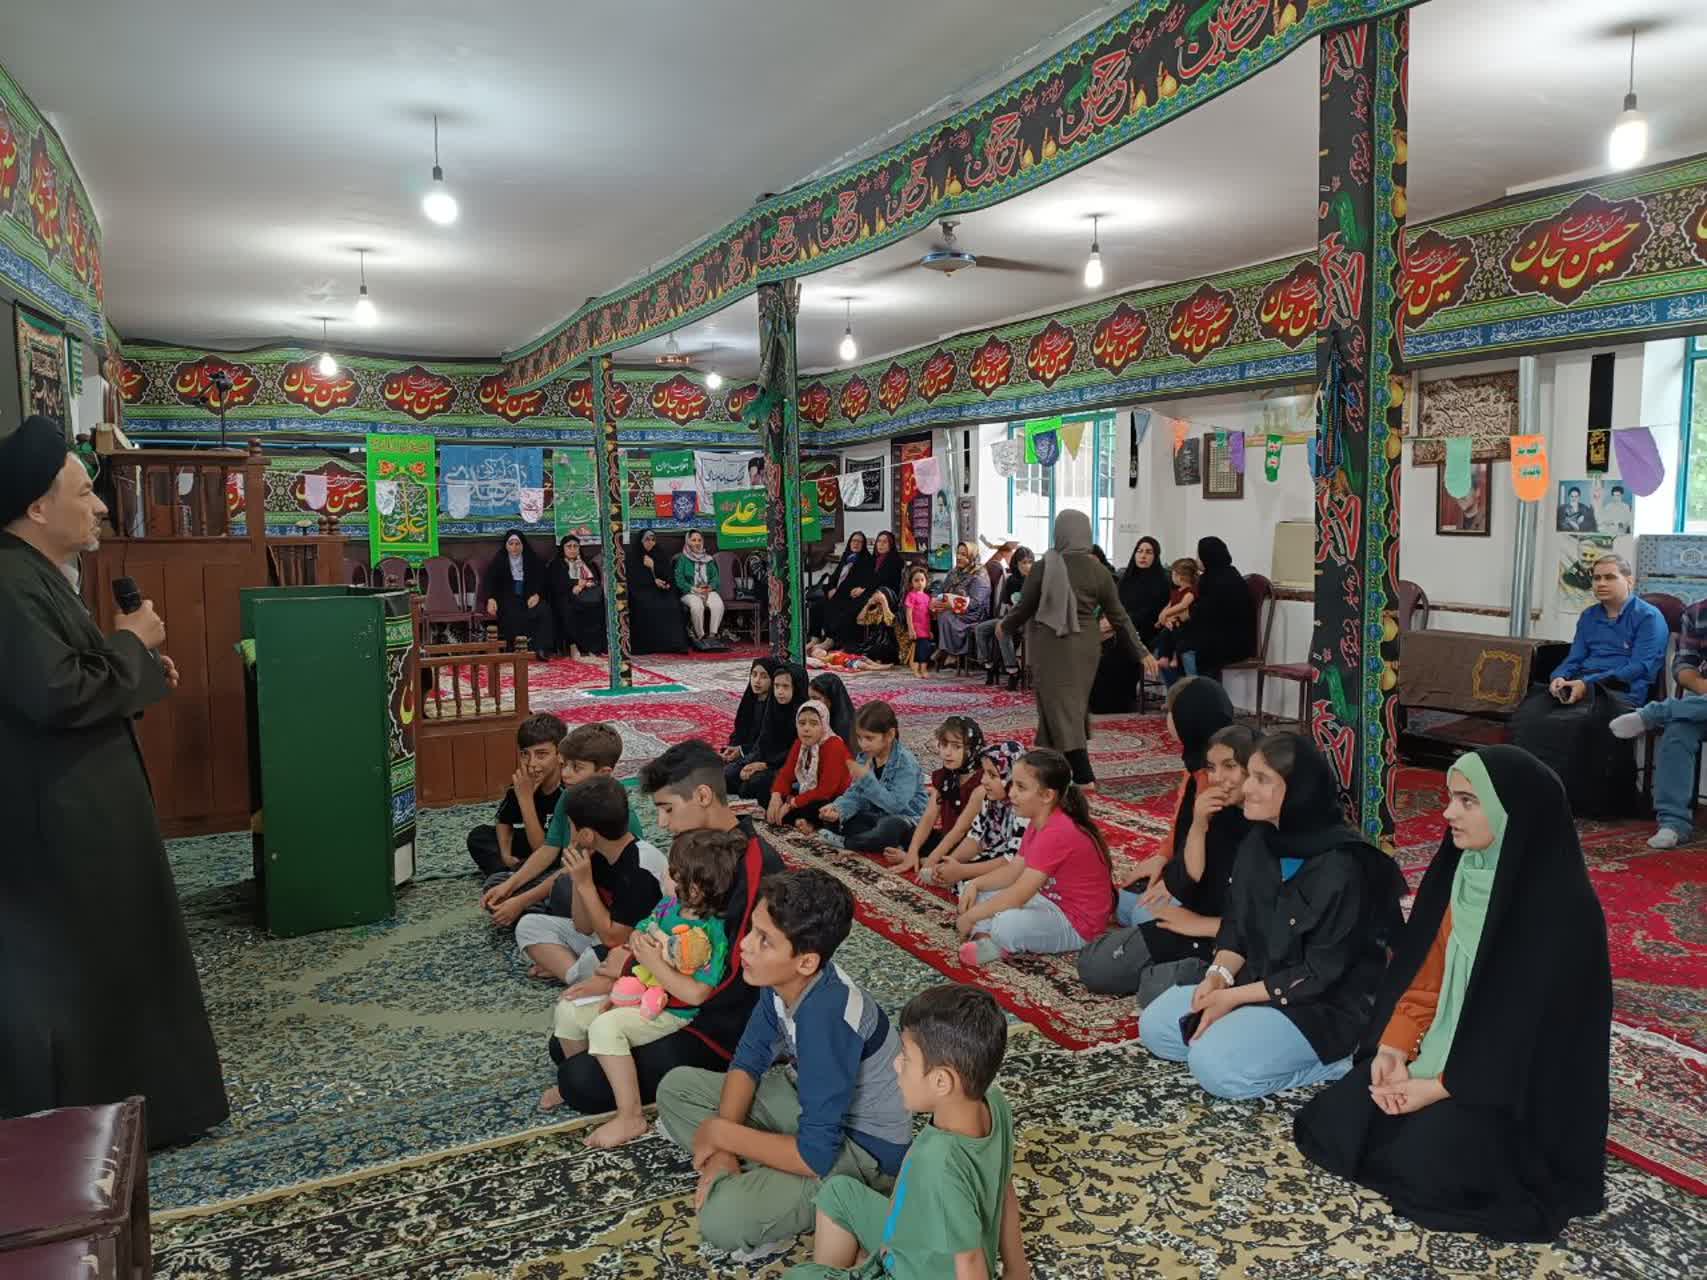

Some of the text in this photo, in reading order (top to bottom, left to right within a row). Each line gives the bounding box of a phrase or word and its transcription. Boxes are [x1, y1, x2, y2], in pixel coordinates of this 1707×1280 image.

[1511, 222, 1641, 288] حسین جان
[1408, 257, 1470, 315] حسین
[1169, 311, 1197, 349] جان
[1193, 305, 1232, 352] حسین
[1261, 290, 1295, 333] جان
[1028, 341, 1074, 379] حسین جان
[1094, 324, 1147, 367] حسین جان
[284, 368, 354, 408] حسین جان
[970, 355, 1011, 388] حسین جان
[384, 380, 452, 414] حسین جان
[479, 384, 541, 417] حسین جان
[651, 390, 706, 420] حسین جان
[327, 484, 367, 513] حسین
